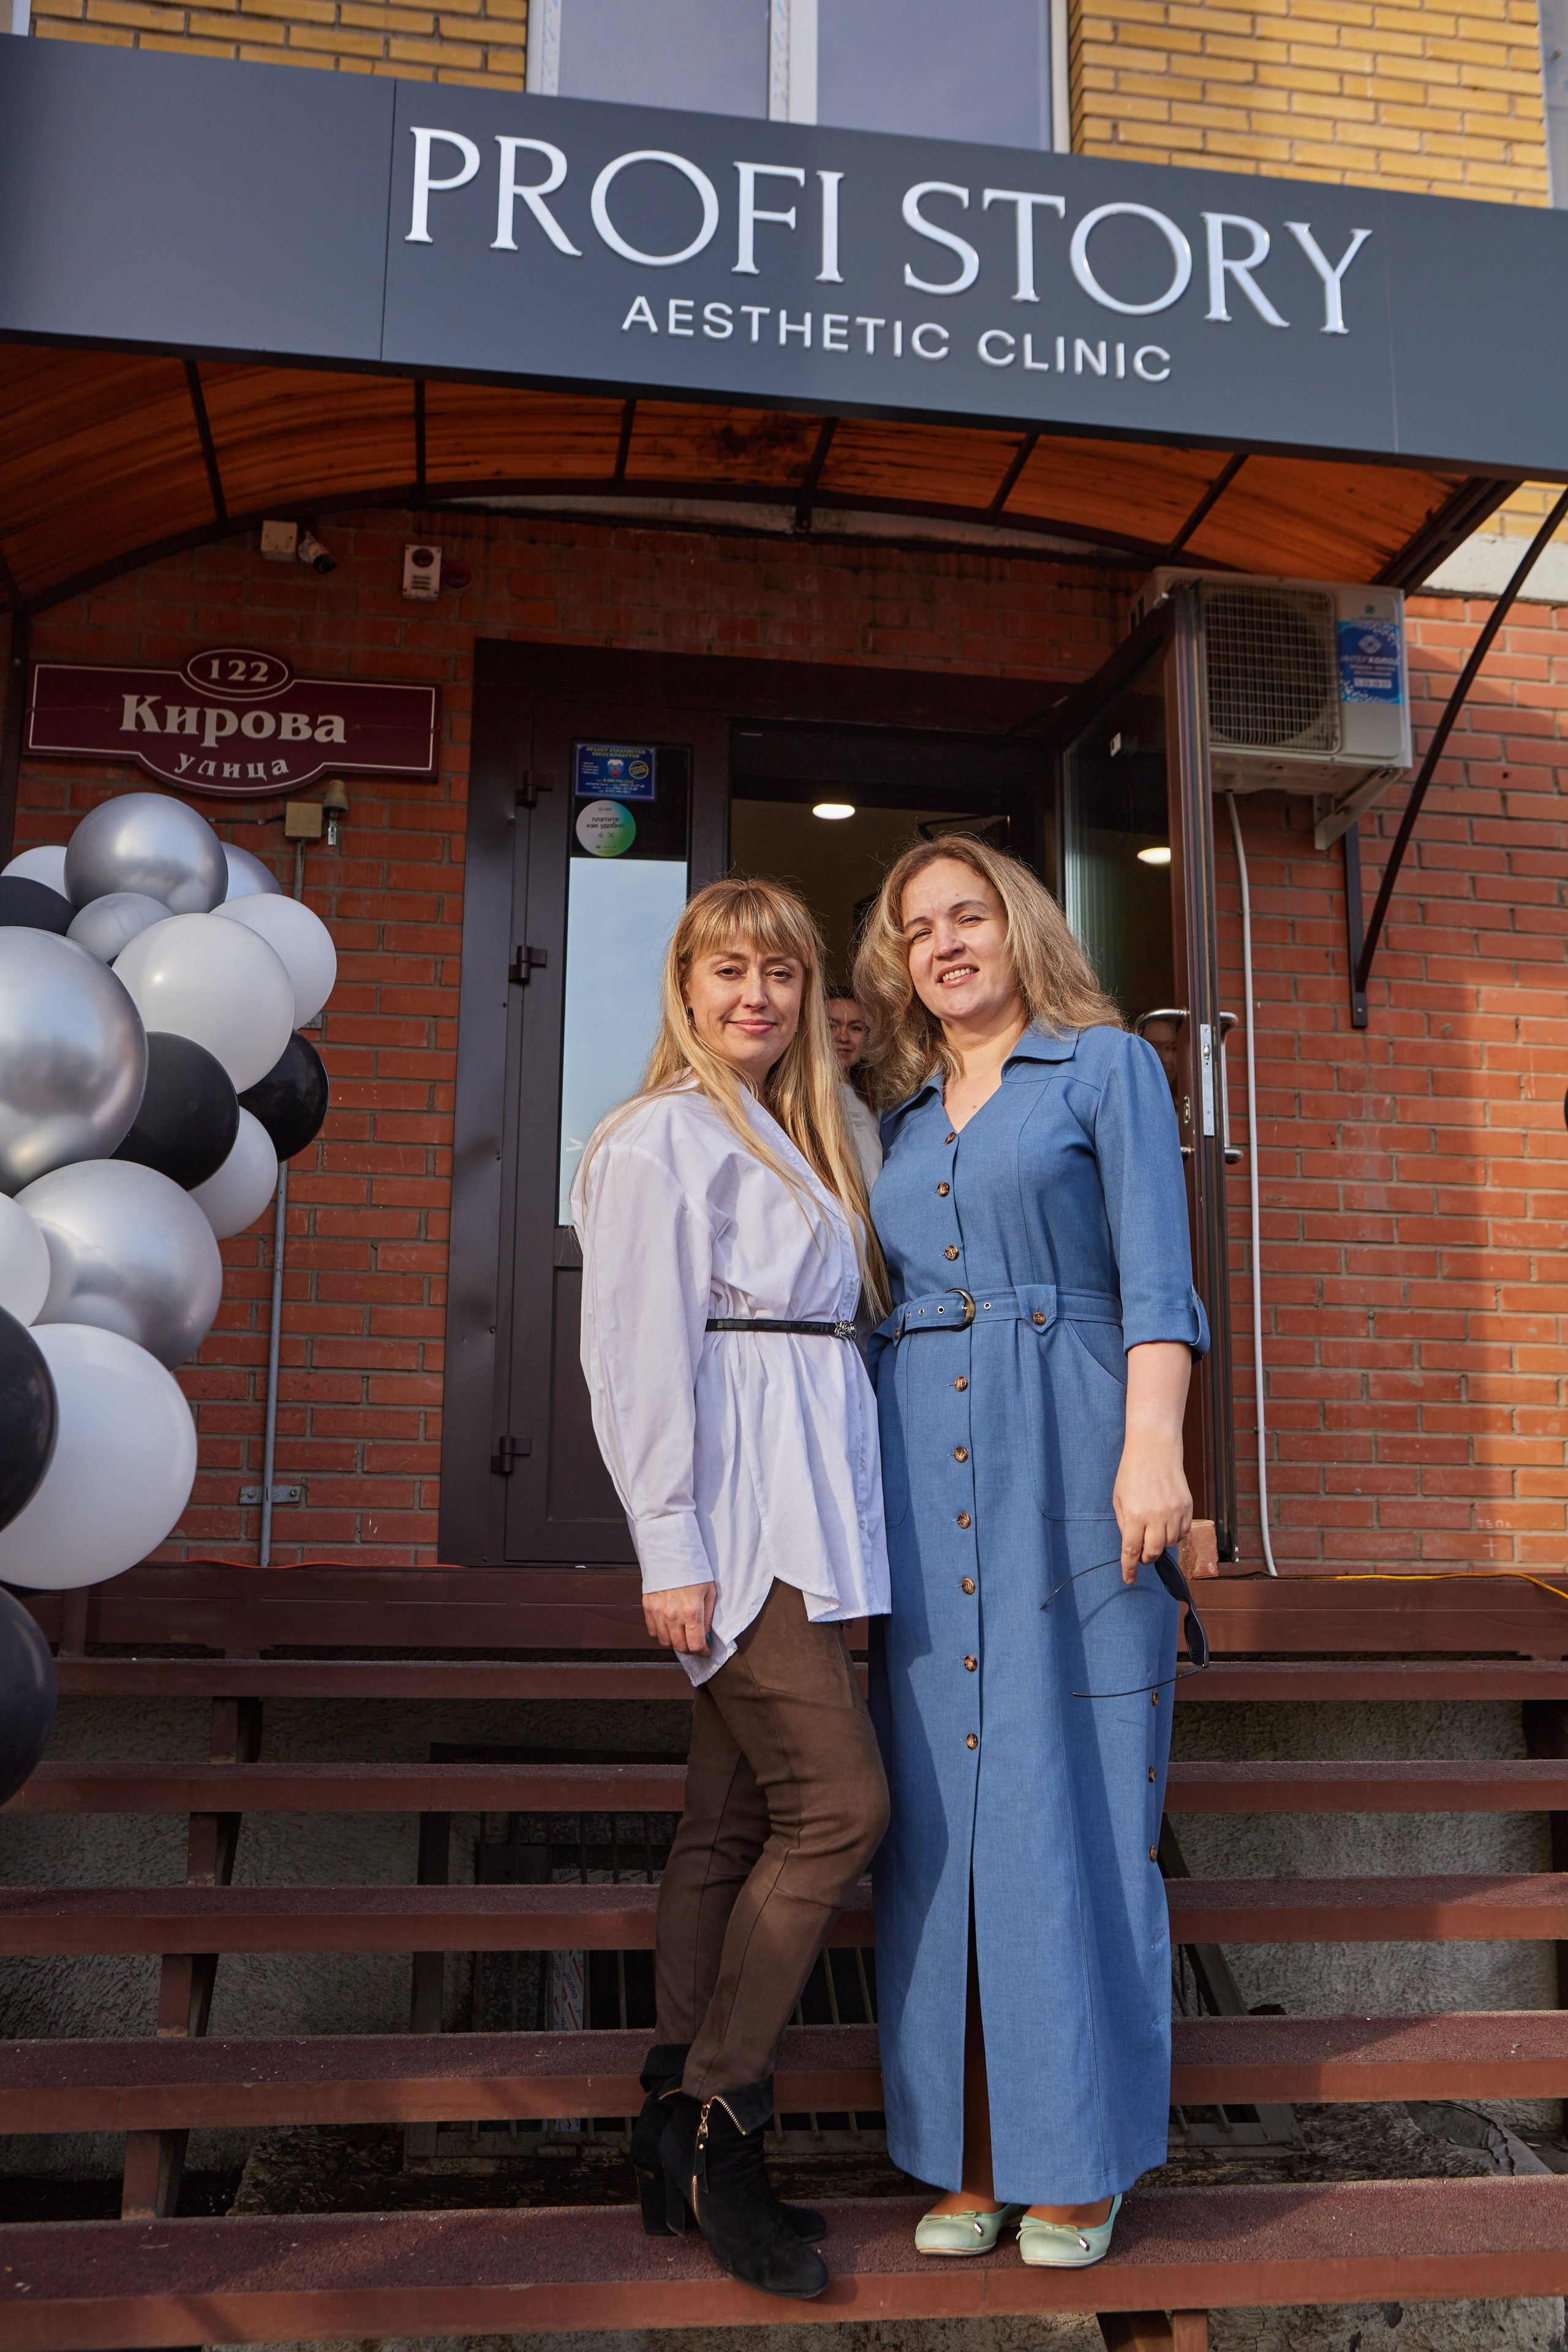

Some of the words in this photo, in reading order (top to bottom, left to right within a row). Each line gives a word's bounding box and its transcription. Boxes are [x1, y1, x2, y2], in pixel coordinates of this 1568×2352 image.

[404, 126, 845, 283] PROFI
[902, 181, 1373, 335] STORY
[622, 295, 949, 360] AESTHETIC
[978, 329, 1171, 383] CLINIC
[209, 658, 269, 682] 122
[119, 693, 347, 748] Кирова
[174, 753, 290, 782] улица
